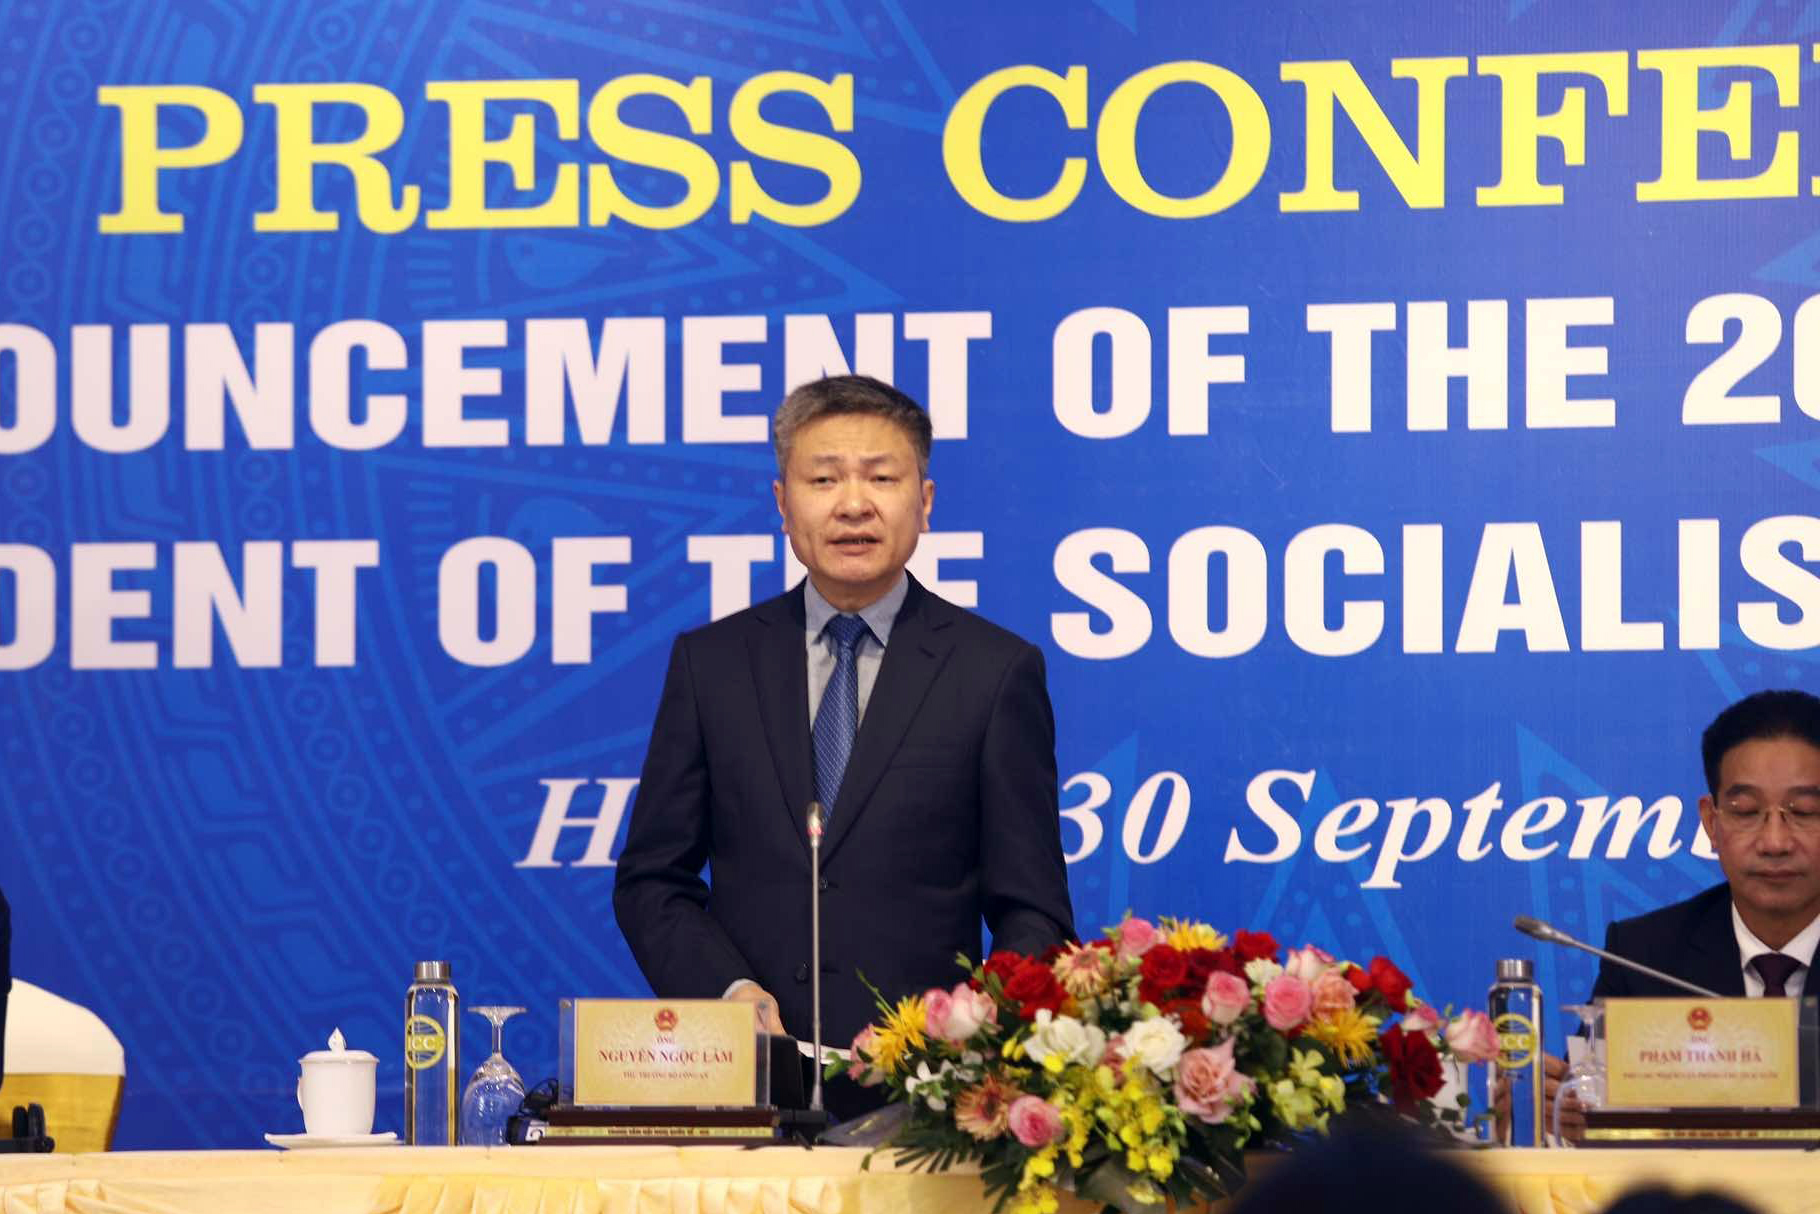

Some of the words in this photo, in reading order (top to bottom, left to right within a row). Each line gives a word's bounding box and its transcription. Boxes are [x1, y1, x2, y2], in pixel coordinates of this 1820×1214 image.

[98, 72, 862, 234] PRESS
[942, 43, 1820, 222] CONFE
[1052, 306, 1250, 439] OF
[1306, 297, 1616, 433] THE
[1681, 292, 1820, 426] 2
[438, 537, 632, 667] OF
[687, 531, 984, 625] TE
[1051, 515, 1820, 660] SOCIALIS
[1059, 771, 1191, 864] 30
[1224, 769, 1720, 888] Septem
